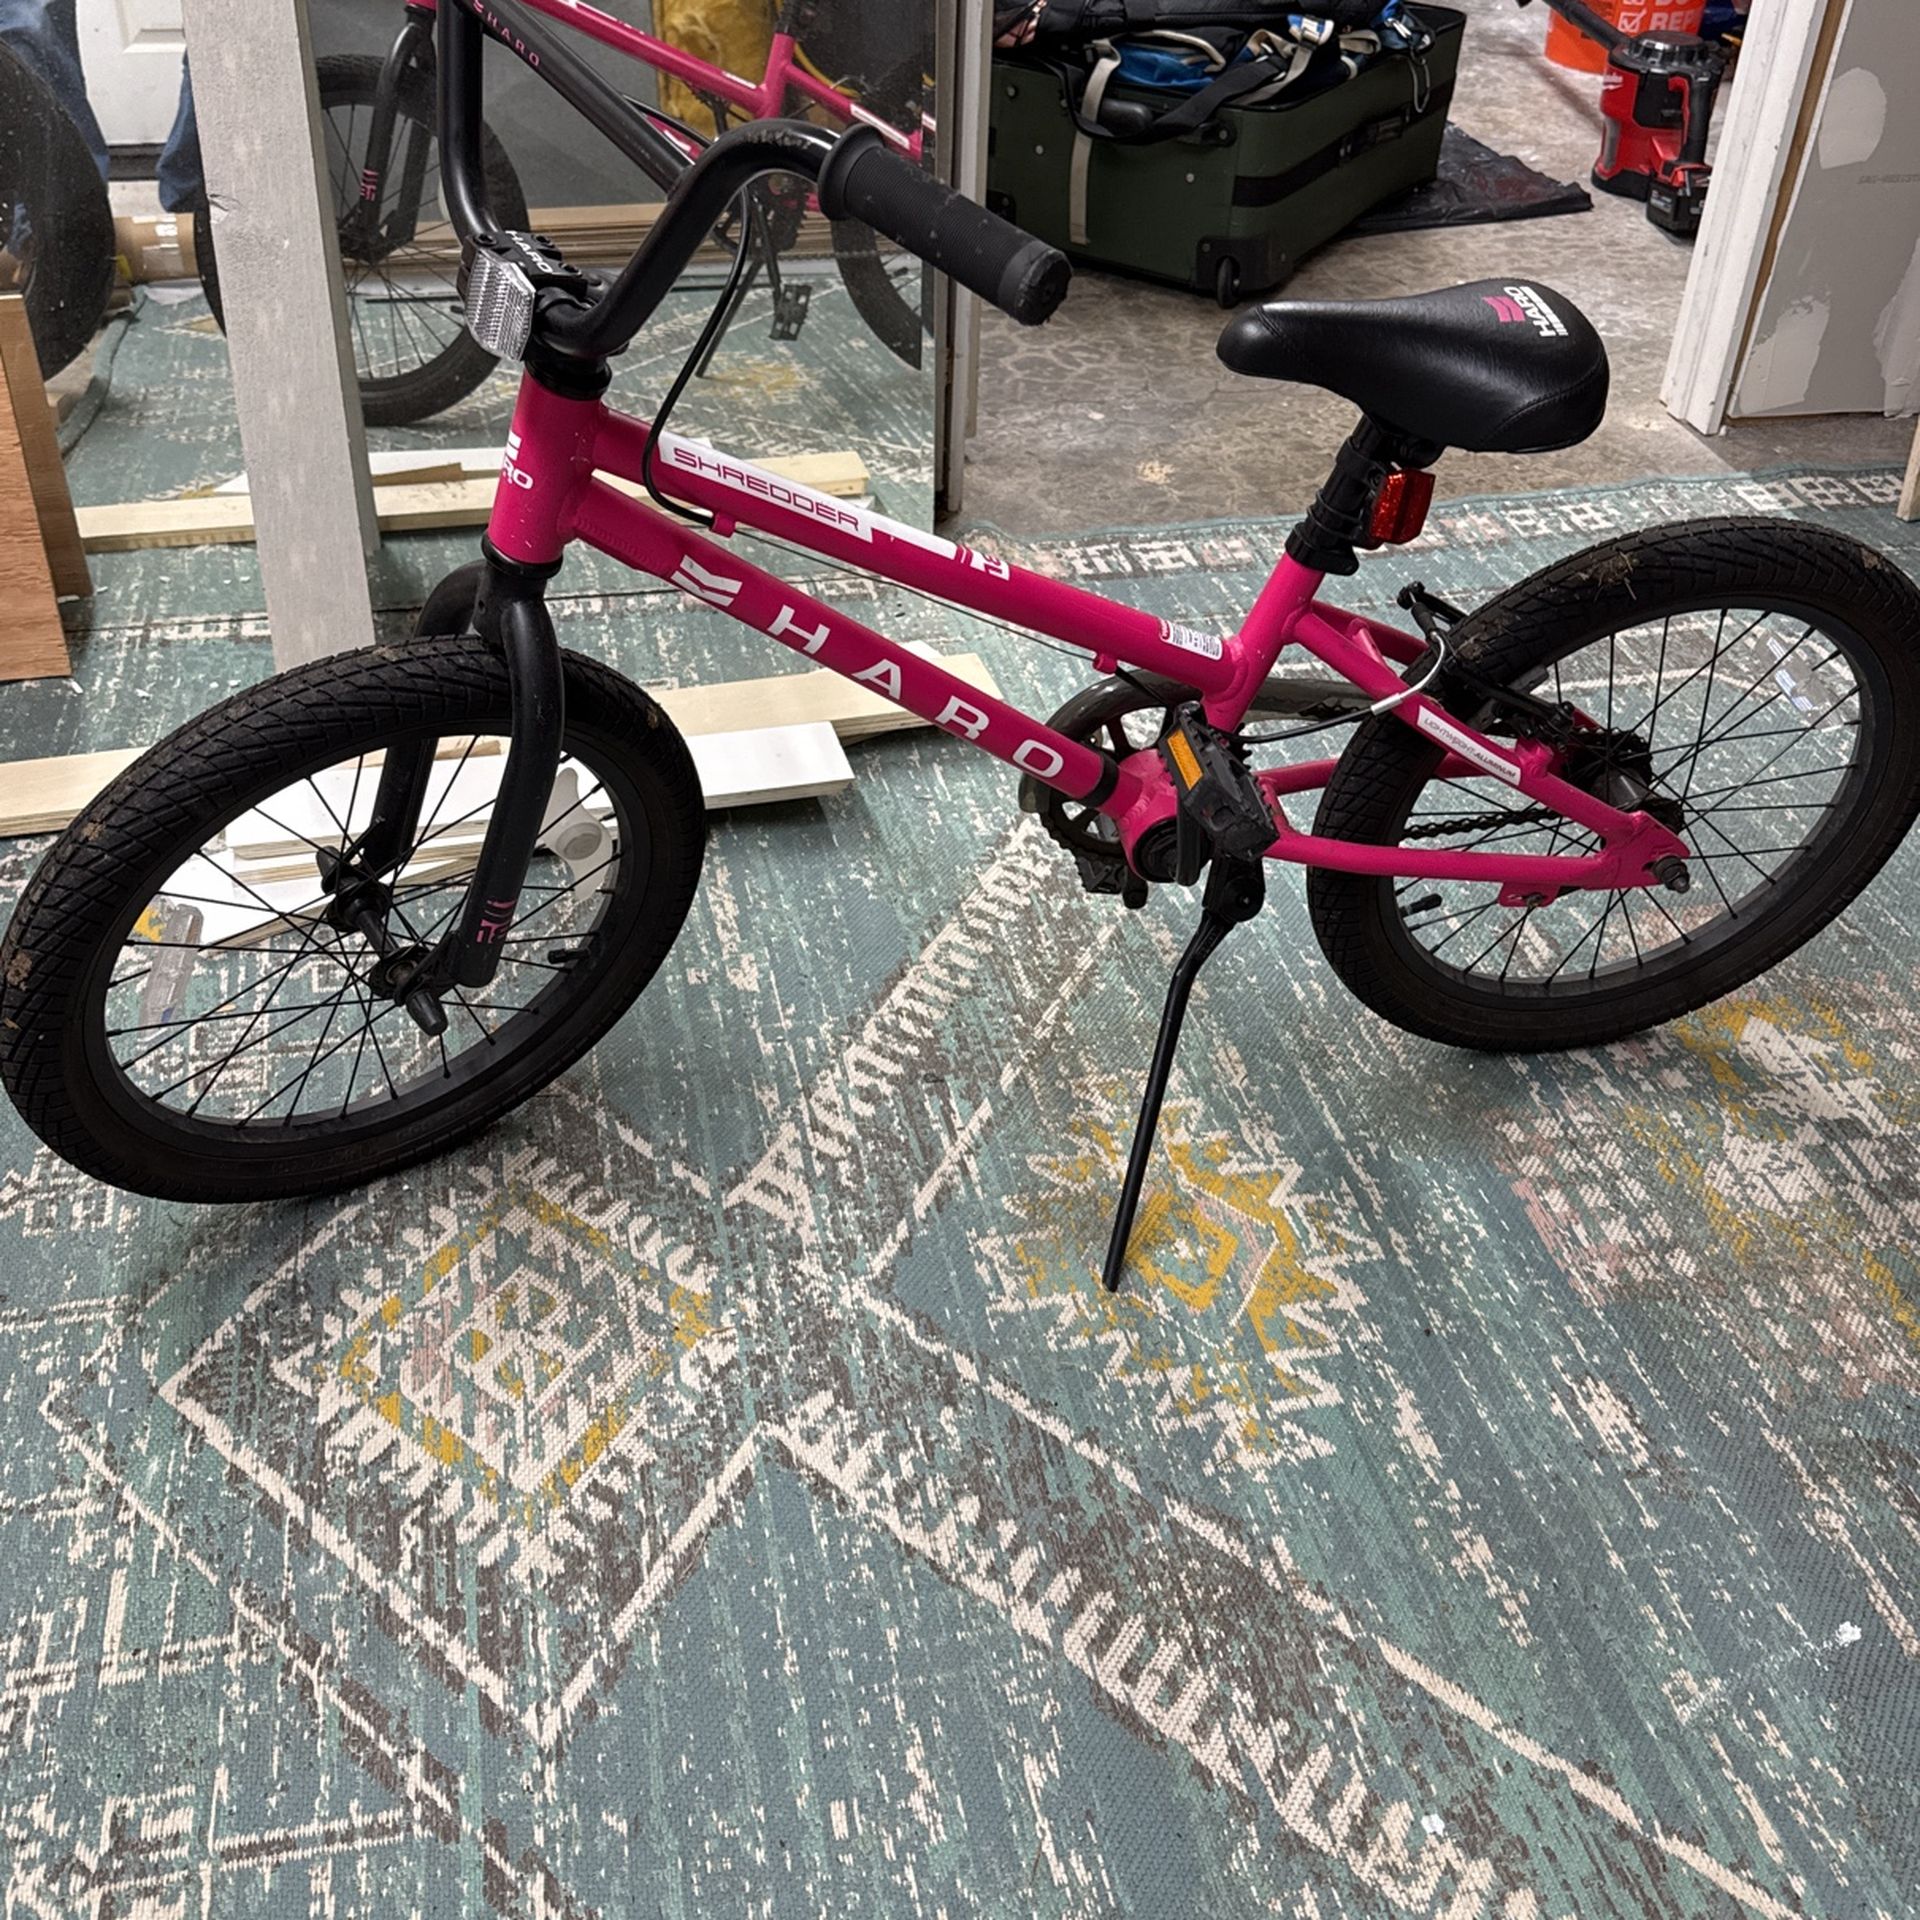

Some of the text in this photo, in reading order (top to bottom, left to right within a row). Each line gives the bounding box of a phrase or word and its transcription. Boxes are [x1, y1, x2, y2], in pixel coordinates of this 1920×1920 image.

[487, 12, 539, 66] HARO
[505, 230, 553, 273] HARO
[1504, 286, 1556, 337] HARO
[674, 447, 859, 531] SHREDDER
[767, 604, 1064, 778] HARO
